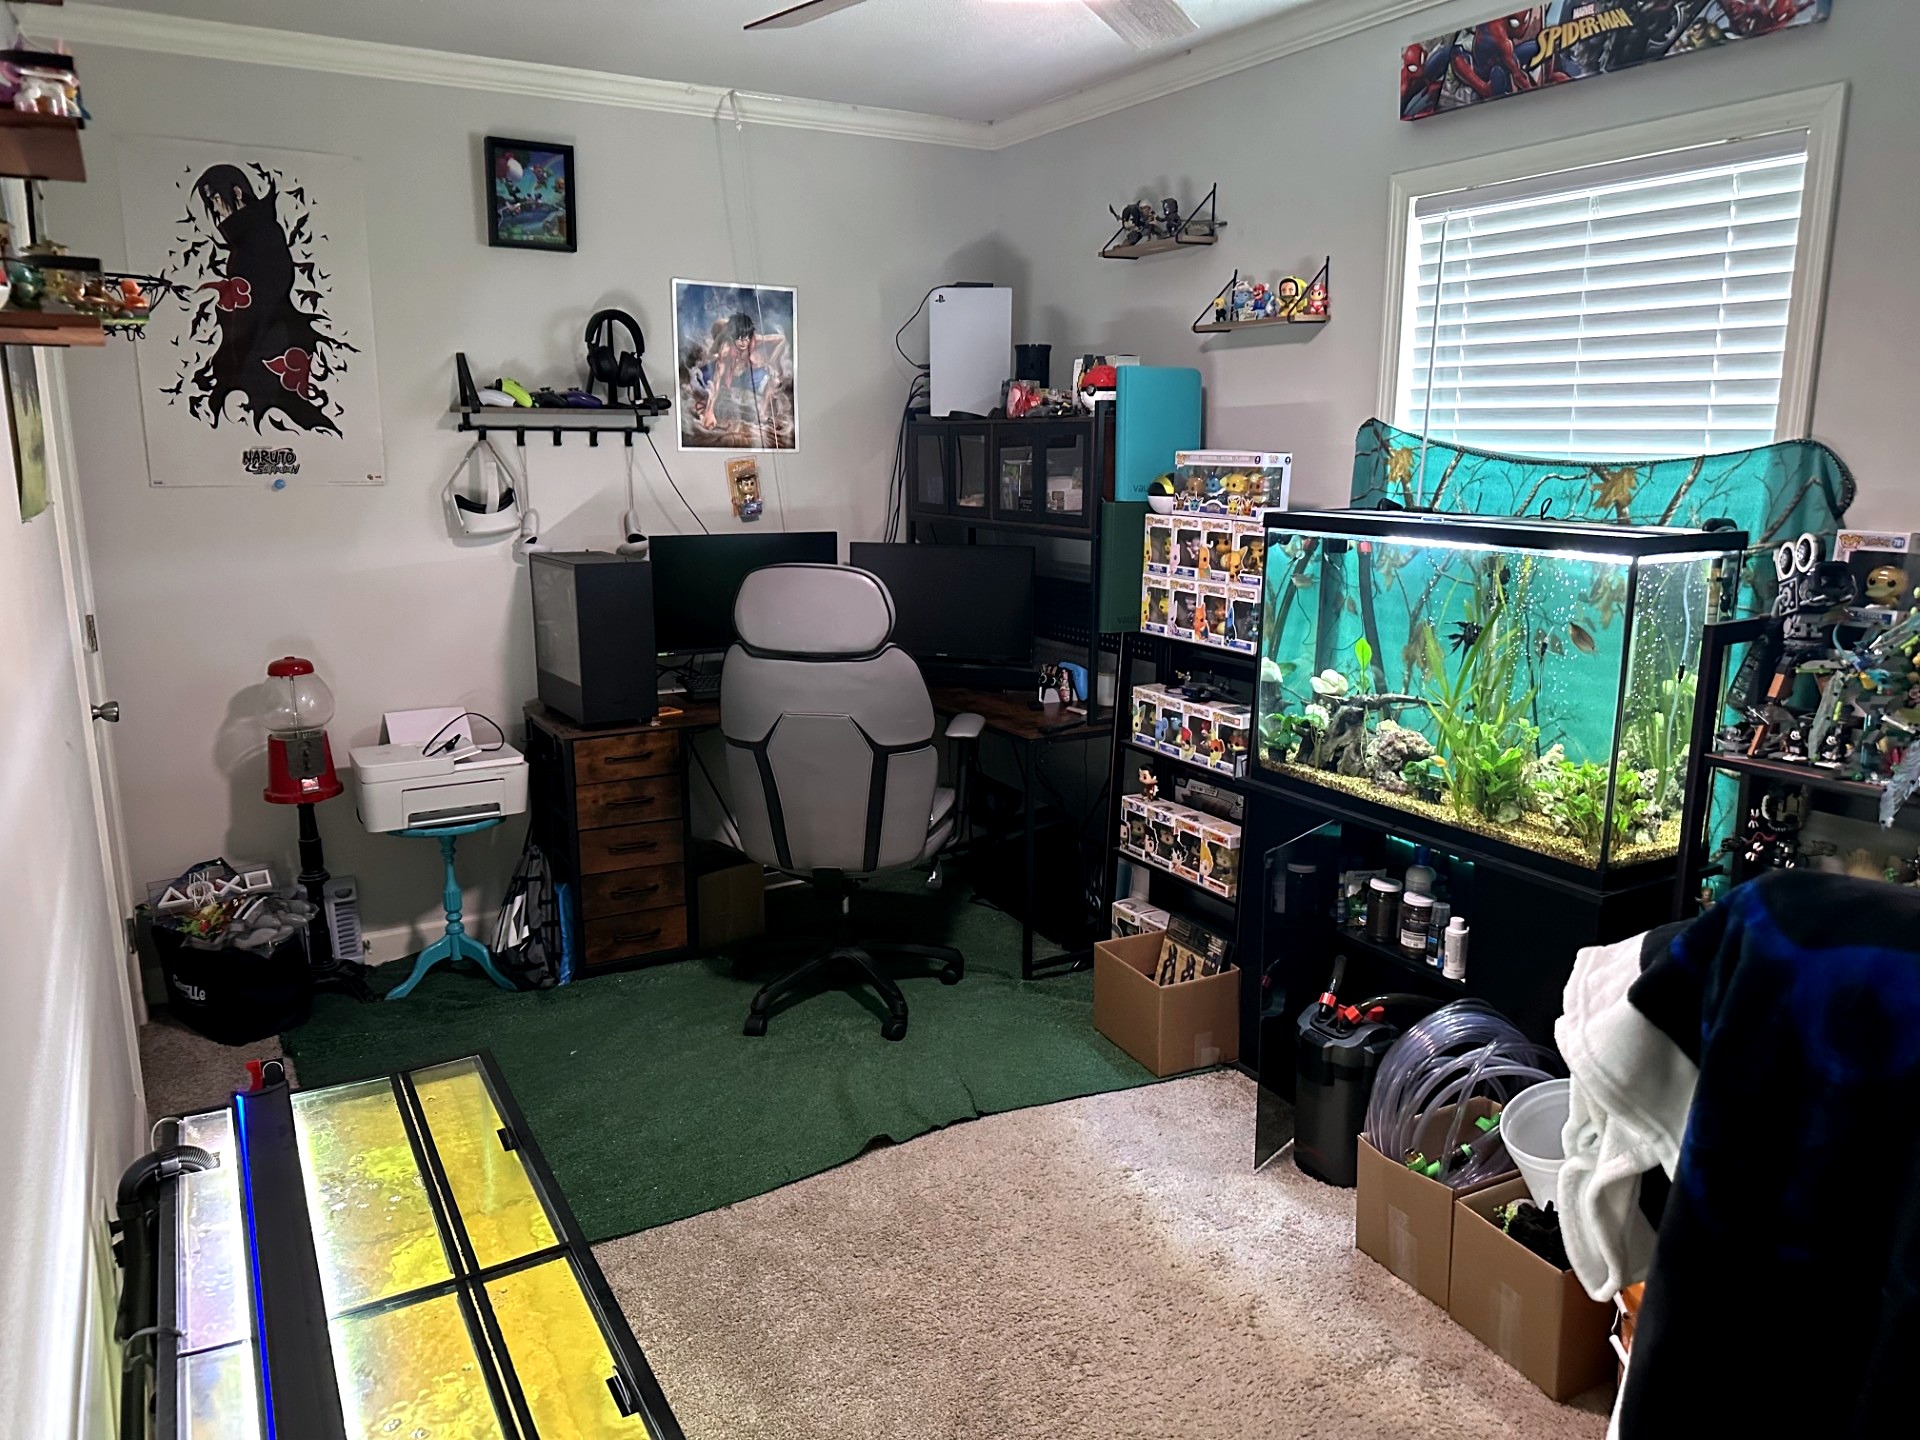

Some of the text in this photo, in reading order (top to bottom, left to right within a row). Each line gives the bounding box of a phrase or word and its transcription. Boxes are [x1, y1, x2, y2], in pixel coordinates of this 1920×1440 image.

[1573, 4, 1595, 19] MARVEL
[1530, 8, 1633, 67] SPIDER-MAN
[242, 448, 297, 465] NARUTO
